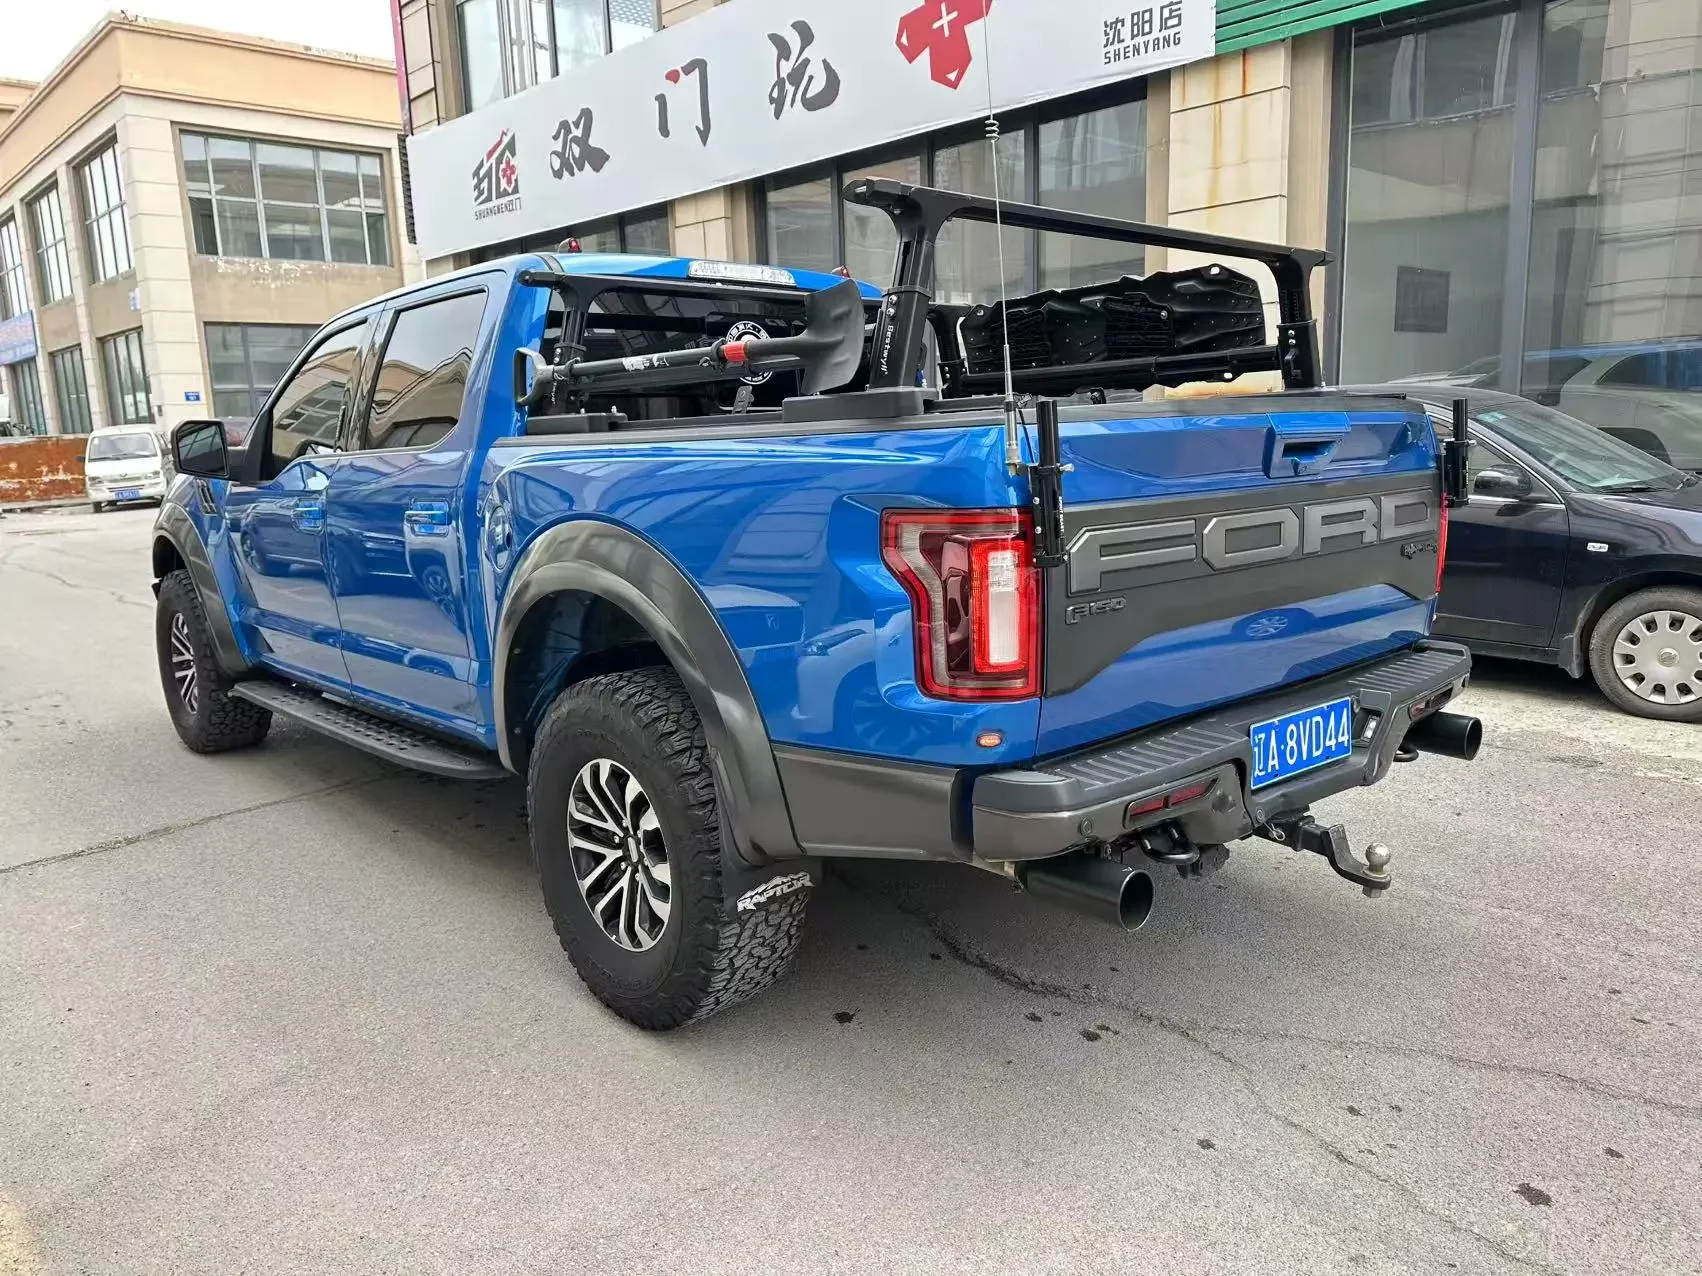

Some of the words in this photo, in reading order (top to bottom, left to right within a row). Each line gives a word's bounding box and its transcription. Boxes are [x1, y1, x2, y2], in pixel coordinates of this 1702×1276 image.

[1103, 1, 1182, 48] 沈阳店
[1104, 31, 1181, 65] SHENYANG
[1067, 490, 1435, 594] FORD
[737, 874, 815, 912] RAPTOR
